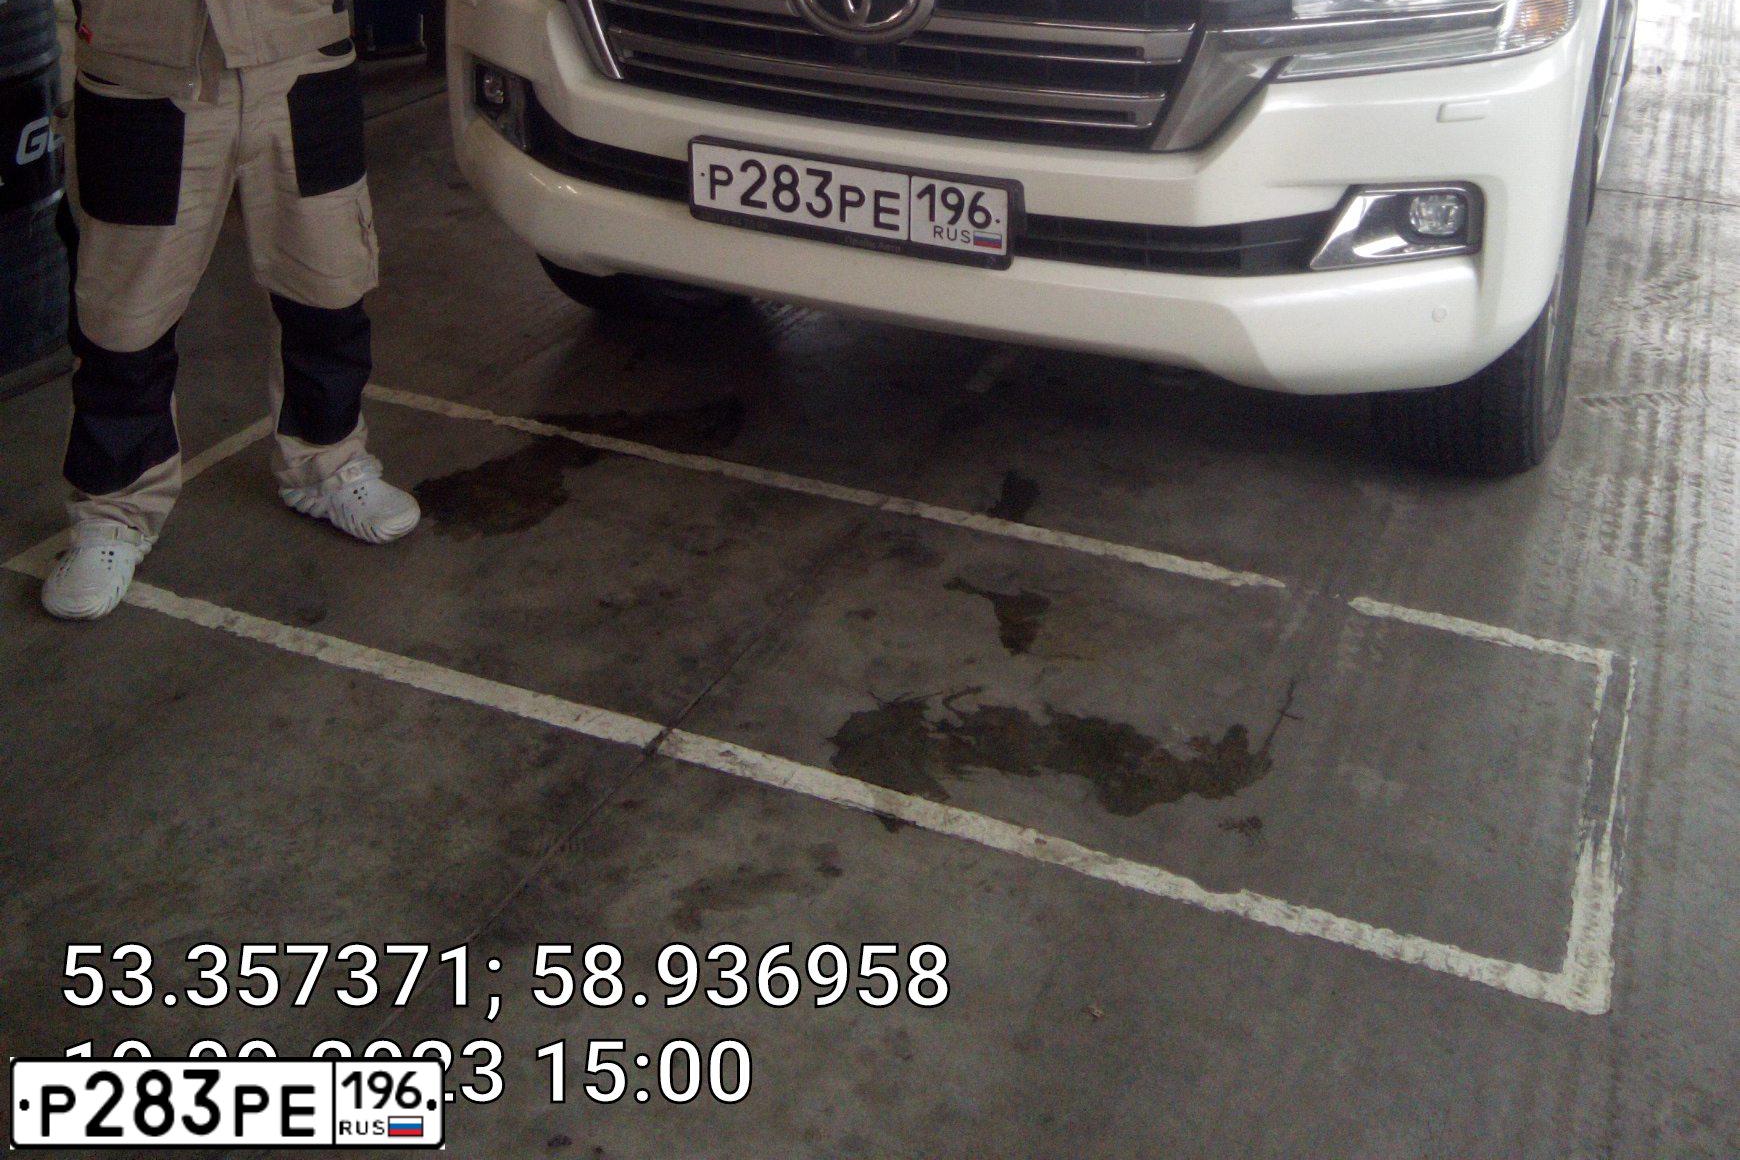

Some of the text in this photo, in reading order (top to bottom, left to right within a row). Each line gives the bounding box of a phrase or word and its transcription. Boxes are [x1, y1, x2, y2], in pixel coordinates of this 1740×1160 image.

[709, 159, 900, 231] Р283РЕ
[916, 183, 992, 226] 196
[933, 226, 971, 244] RUS
